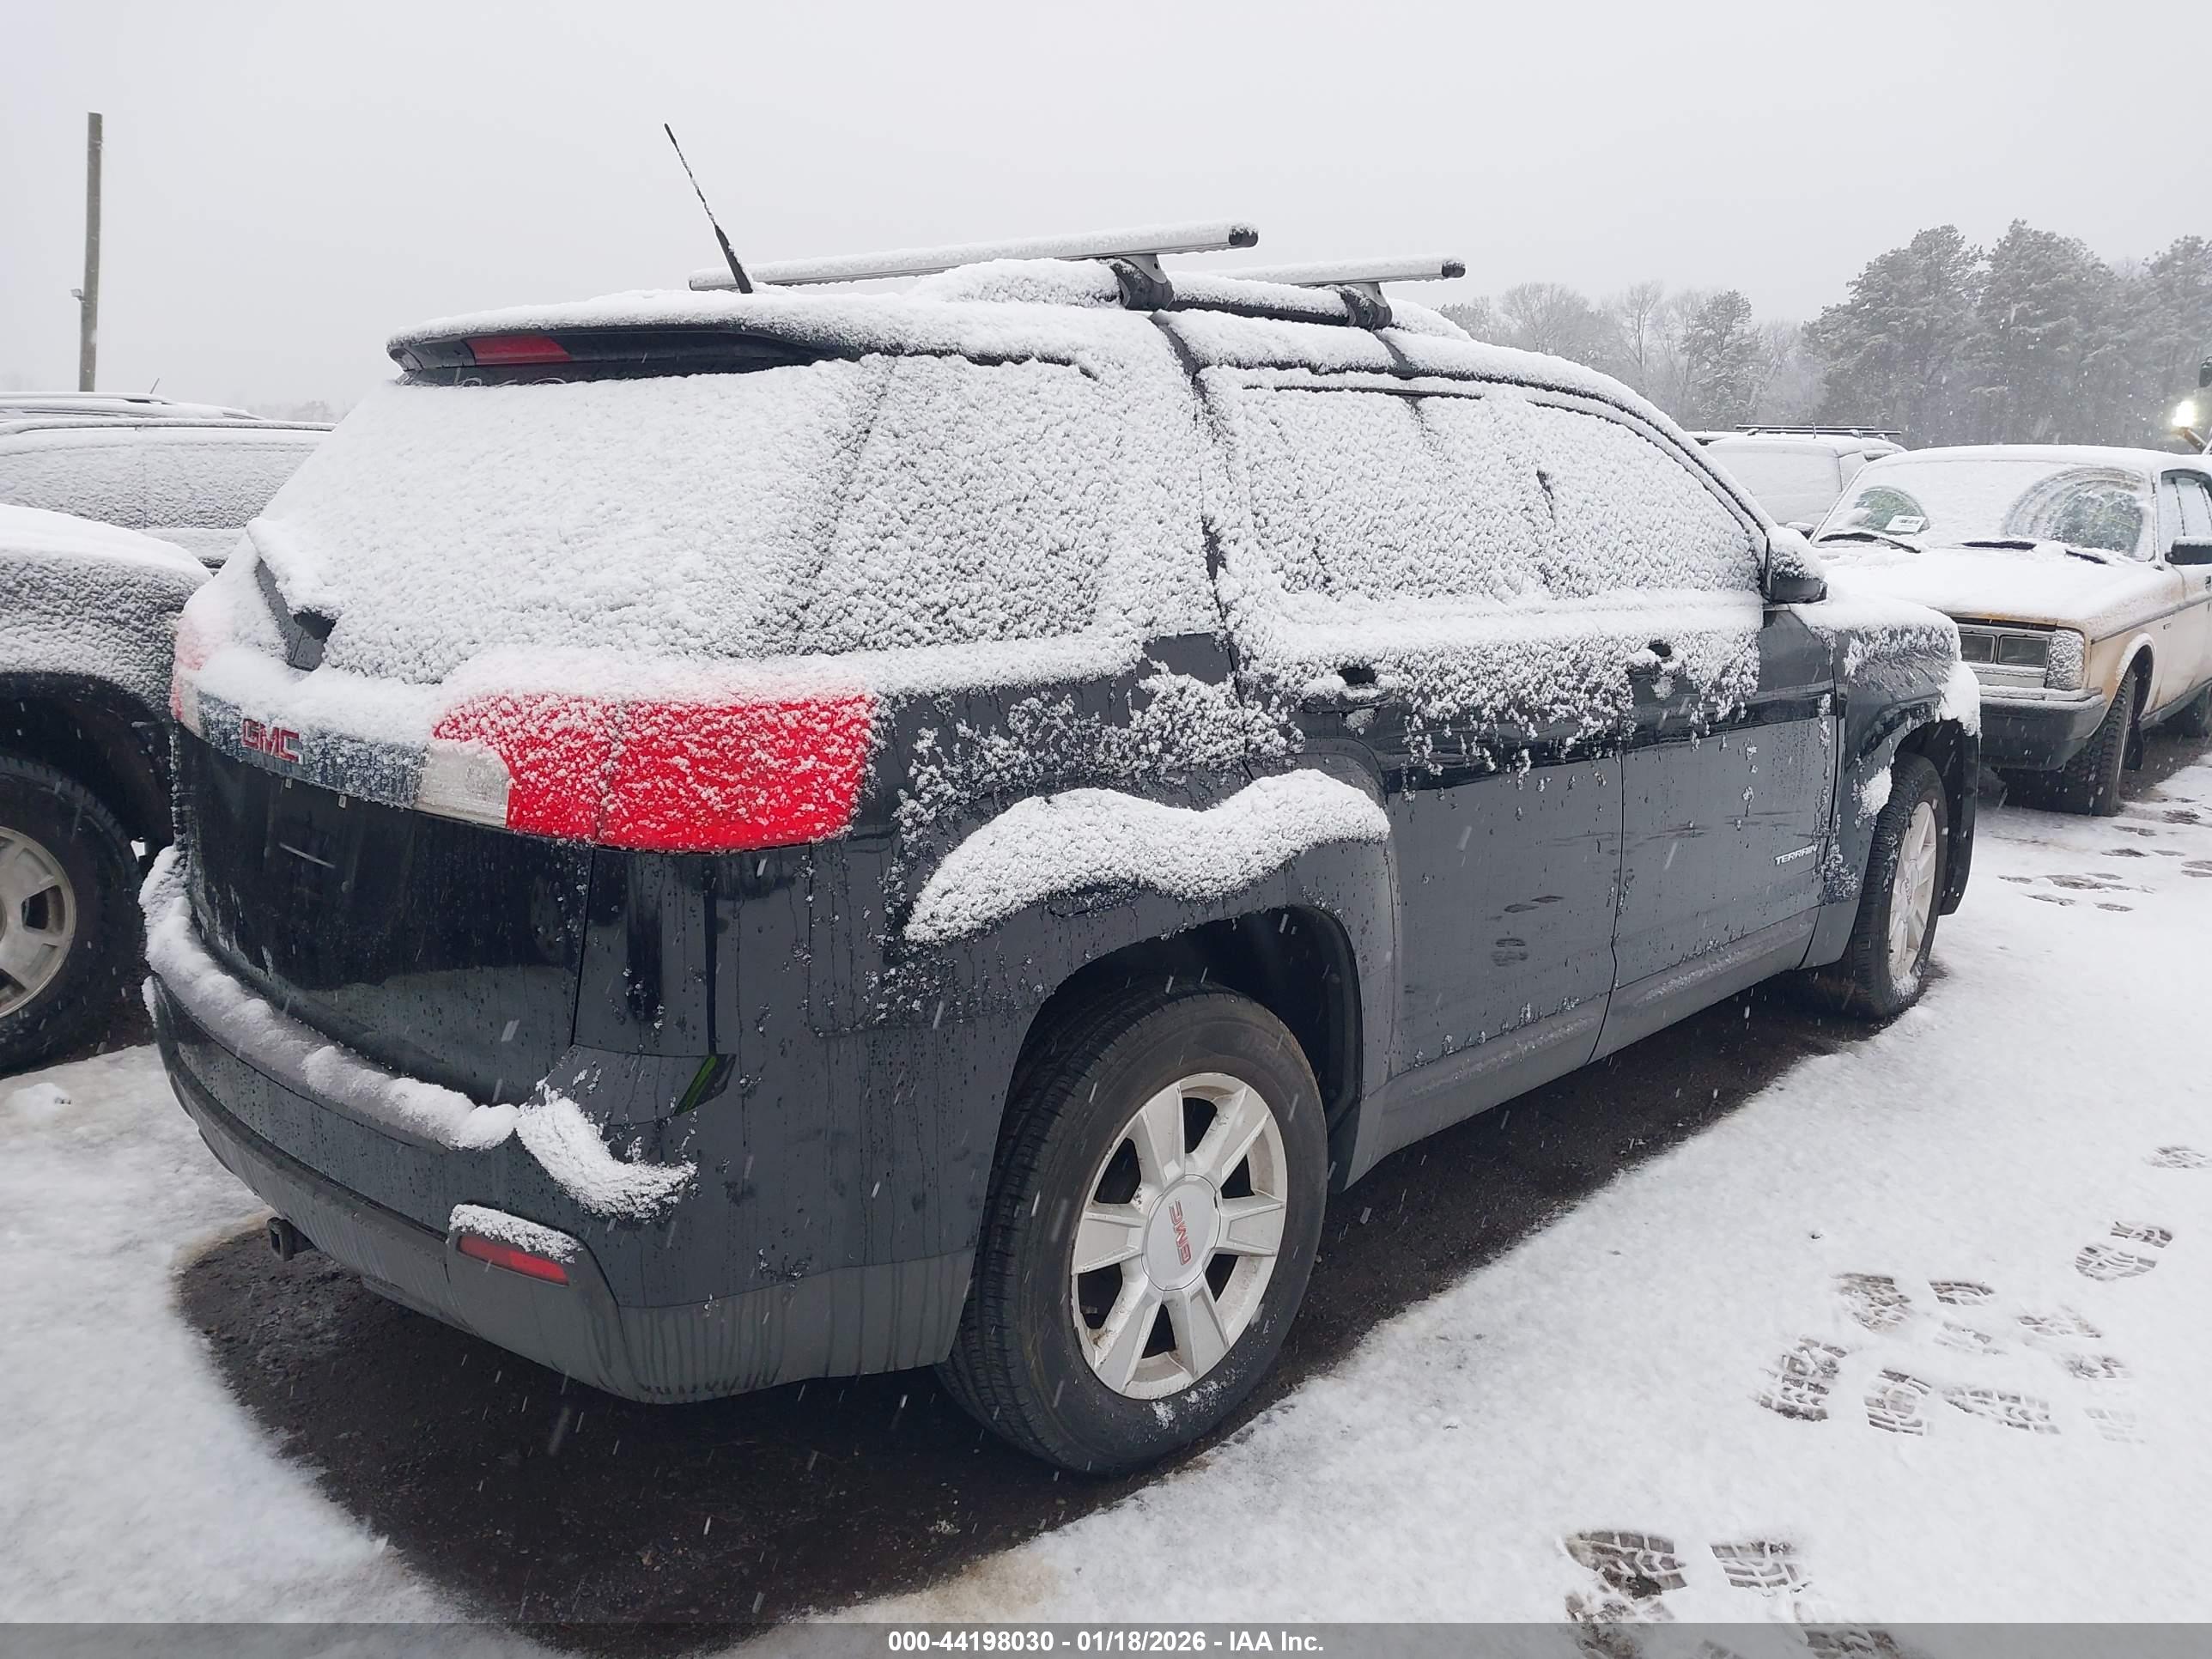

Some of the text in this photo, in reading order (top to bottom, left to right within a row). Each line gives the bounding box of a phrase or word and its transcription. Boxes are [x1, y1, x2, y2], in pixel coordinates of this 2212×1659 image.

[242, 718, 304, 764] GMC
[1774, 843, 1819, 866] TERRAIN
[1169, 1198, 1192, 1266] GMC
